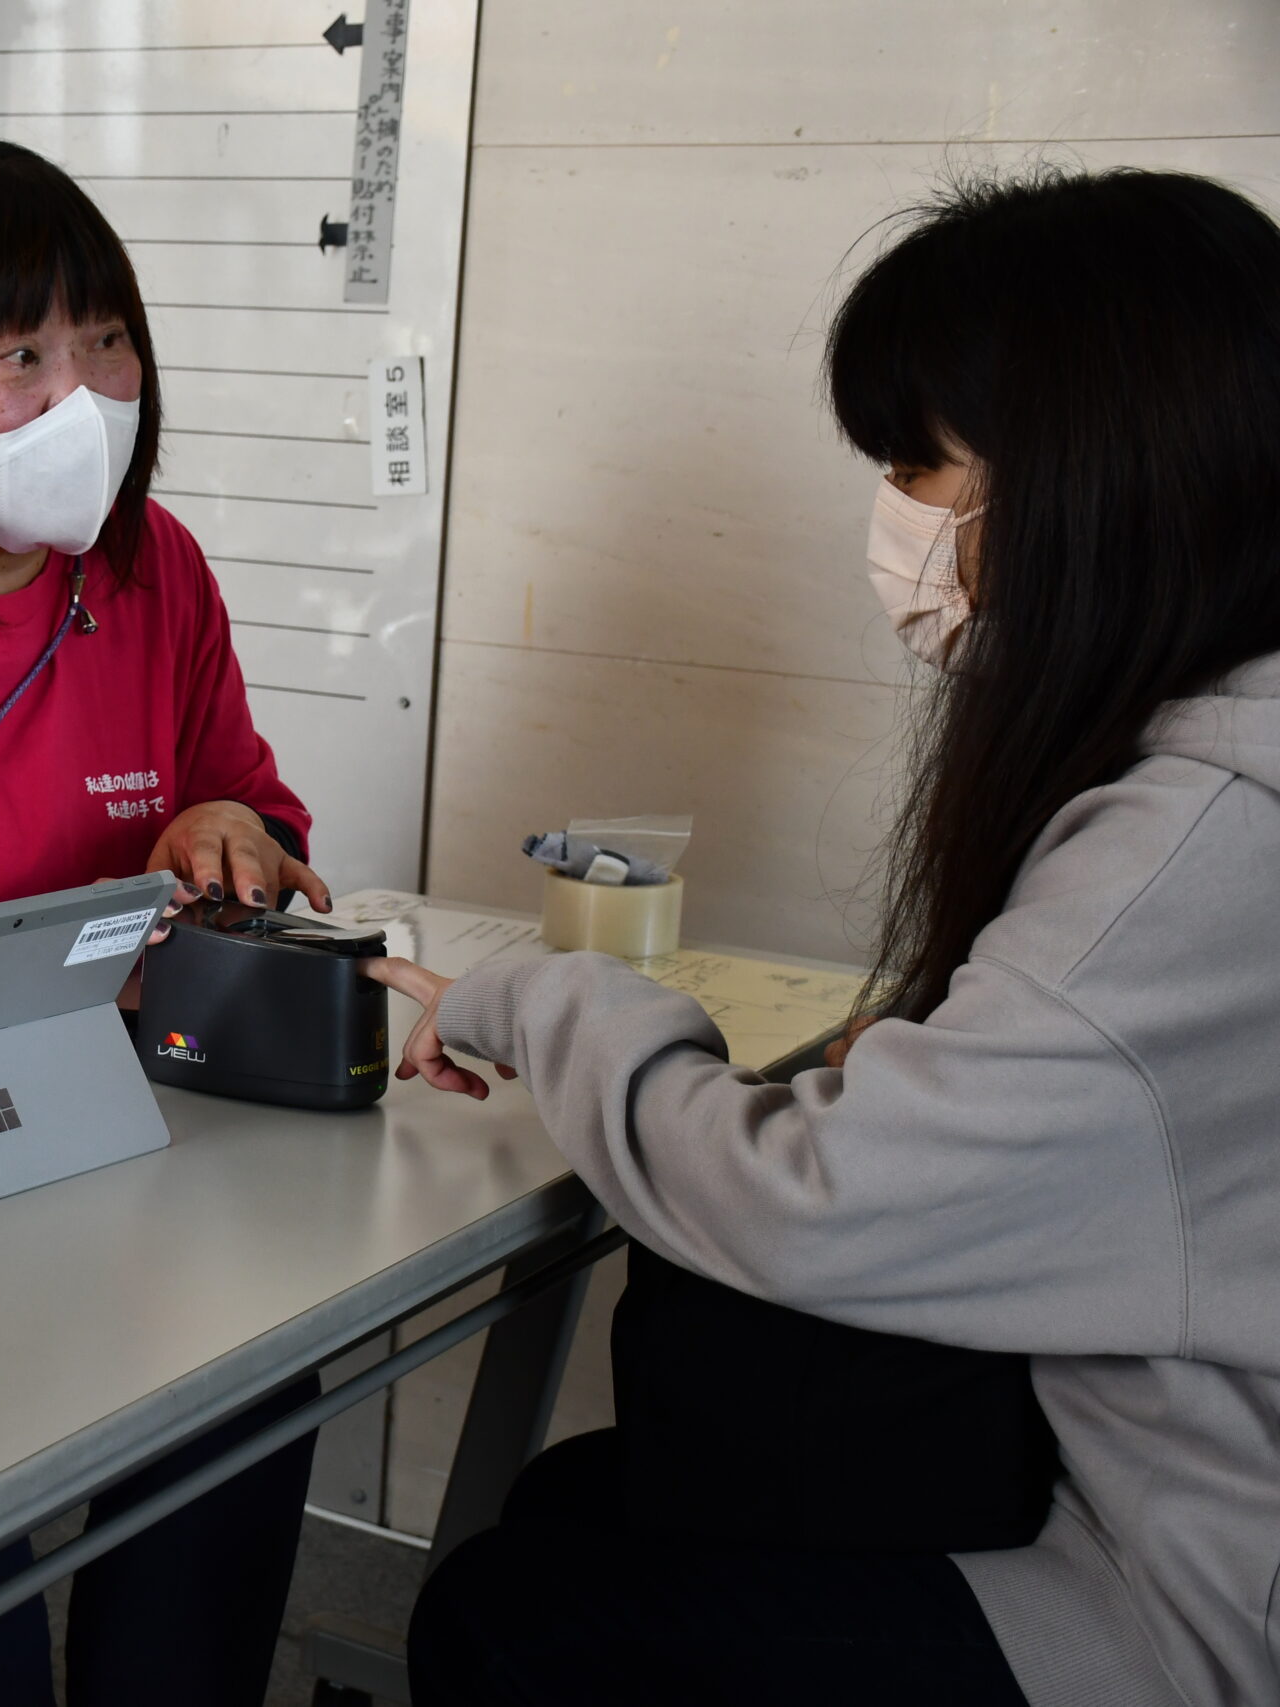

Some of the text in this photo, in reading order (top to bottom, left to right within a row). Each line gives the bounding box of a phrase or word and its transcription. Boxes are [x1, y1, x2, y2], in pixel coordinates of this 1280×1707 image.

[385, 365, 411, 487] 相談室5
[105, 796, 165, 820] 私達の手で
[349, 1062, 379, 1076] VEGGIE
